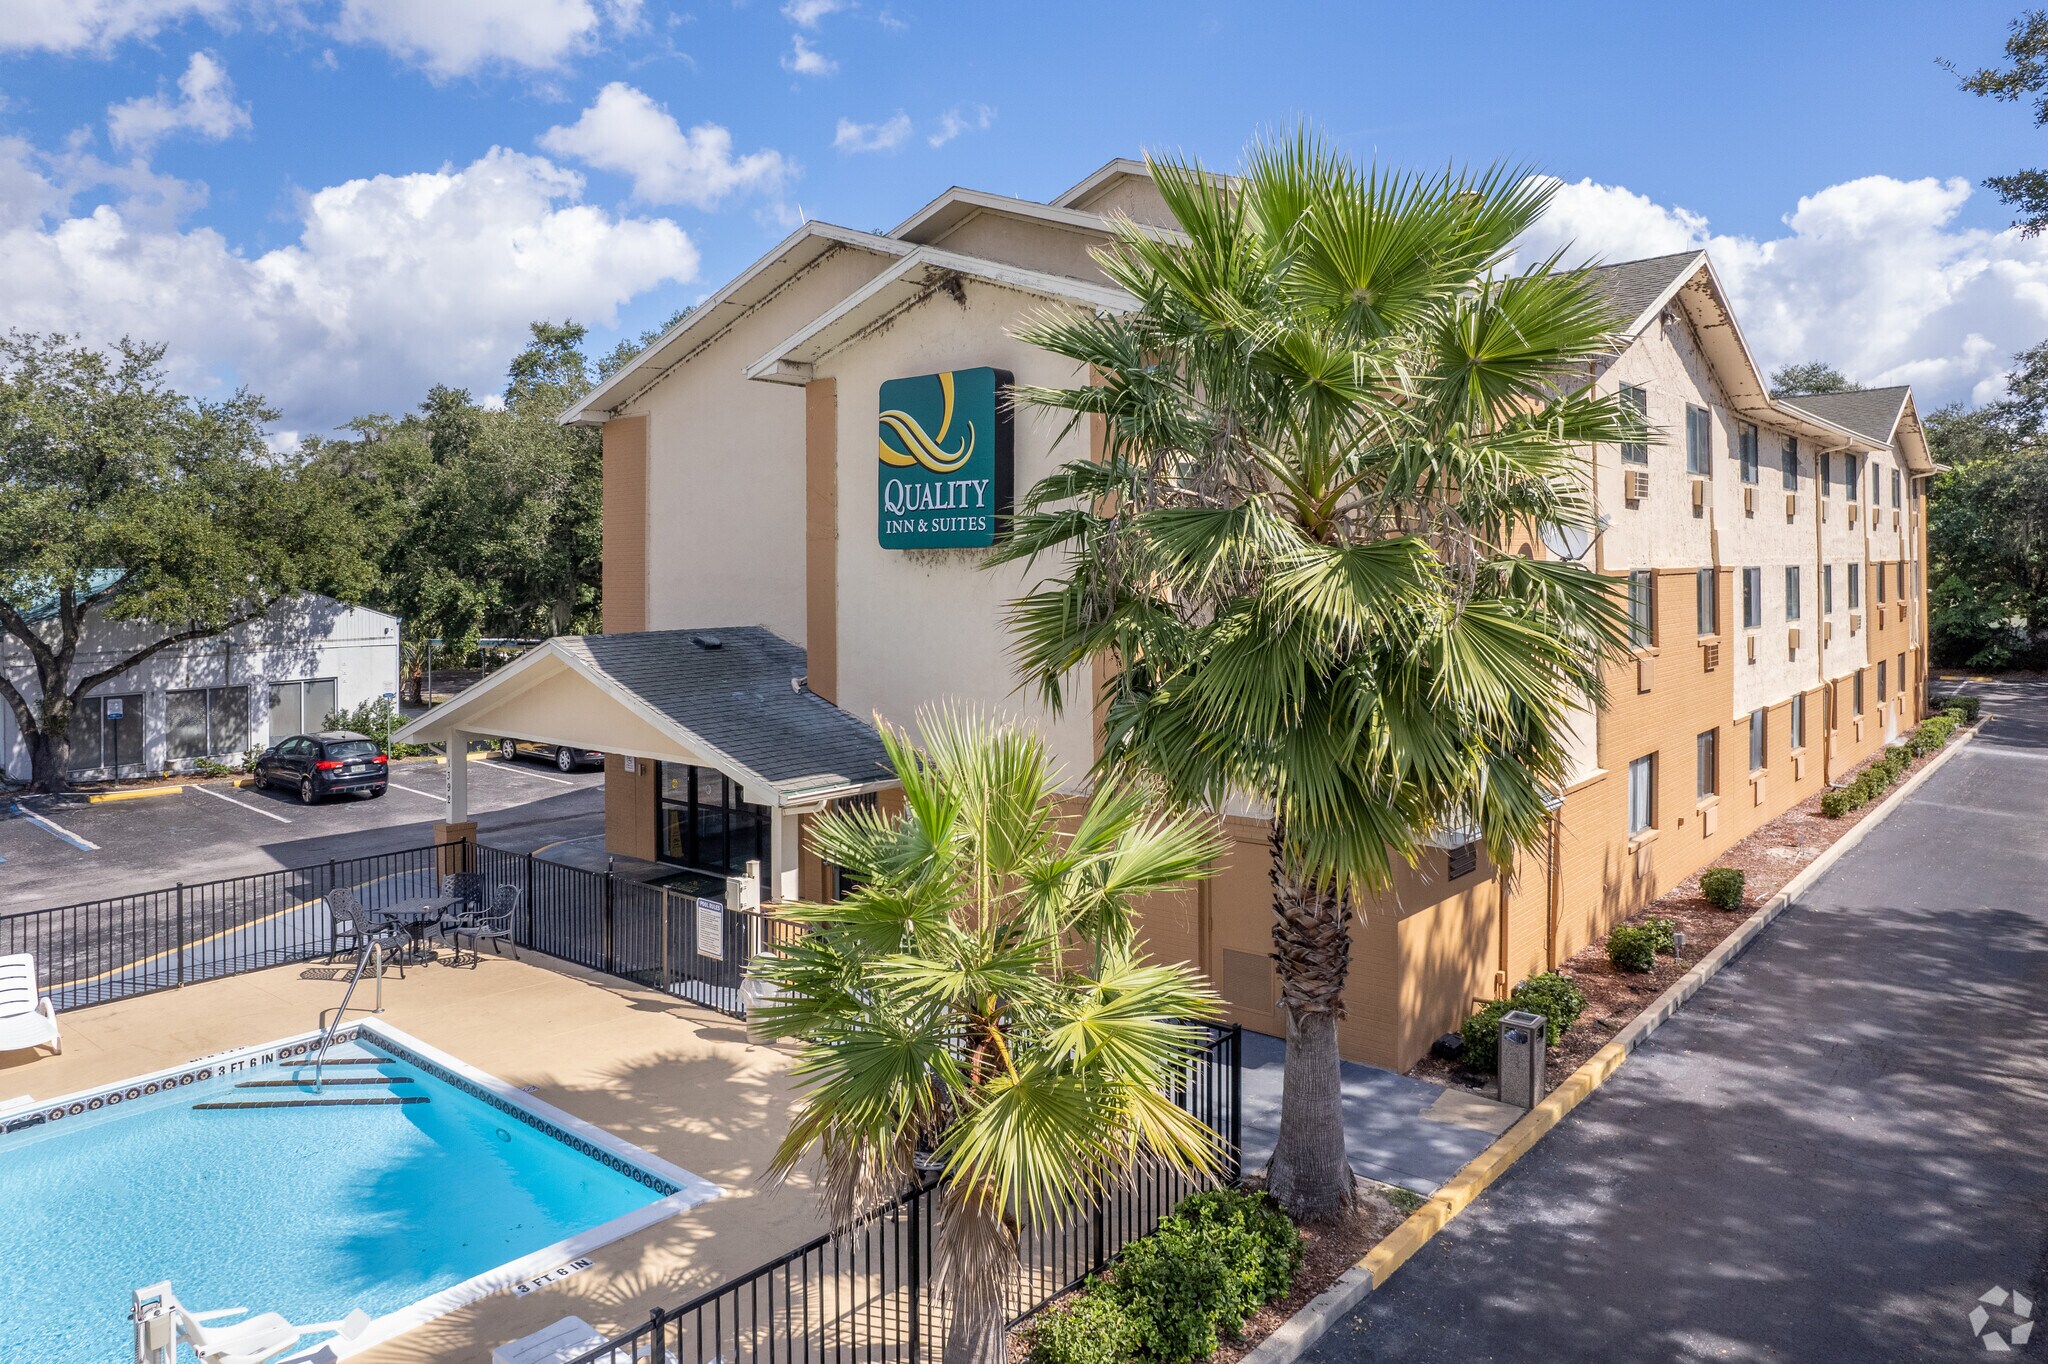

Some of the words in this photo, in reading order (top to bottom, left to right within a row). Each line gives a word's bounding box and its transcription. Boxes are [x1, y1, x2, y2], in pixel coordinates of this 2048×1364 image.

[884, 478, 989, 516] QUALITY
[886, 519, 915, 534] INN
[917, 518, 928, 533] &
[931, 516, 986, 532] SUITES
[699, 900, 709, 908] POOL
[709, 902, 721, 911] RULES
[218, 1065, 226, 1076] 3
[230, 1060, 245, 1073] FT
[249, 1057, 257, 1068] 6
[261, 1052, 274, 1065] IN
[517, 1284, 531, 1293] 3
[556, 1268, 569, 1276] 6
[570, 1259, 593, 1271] IN.
